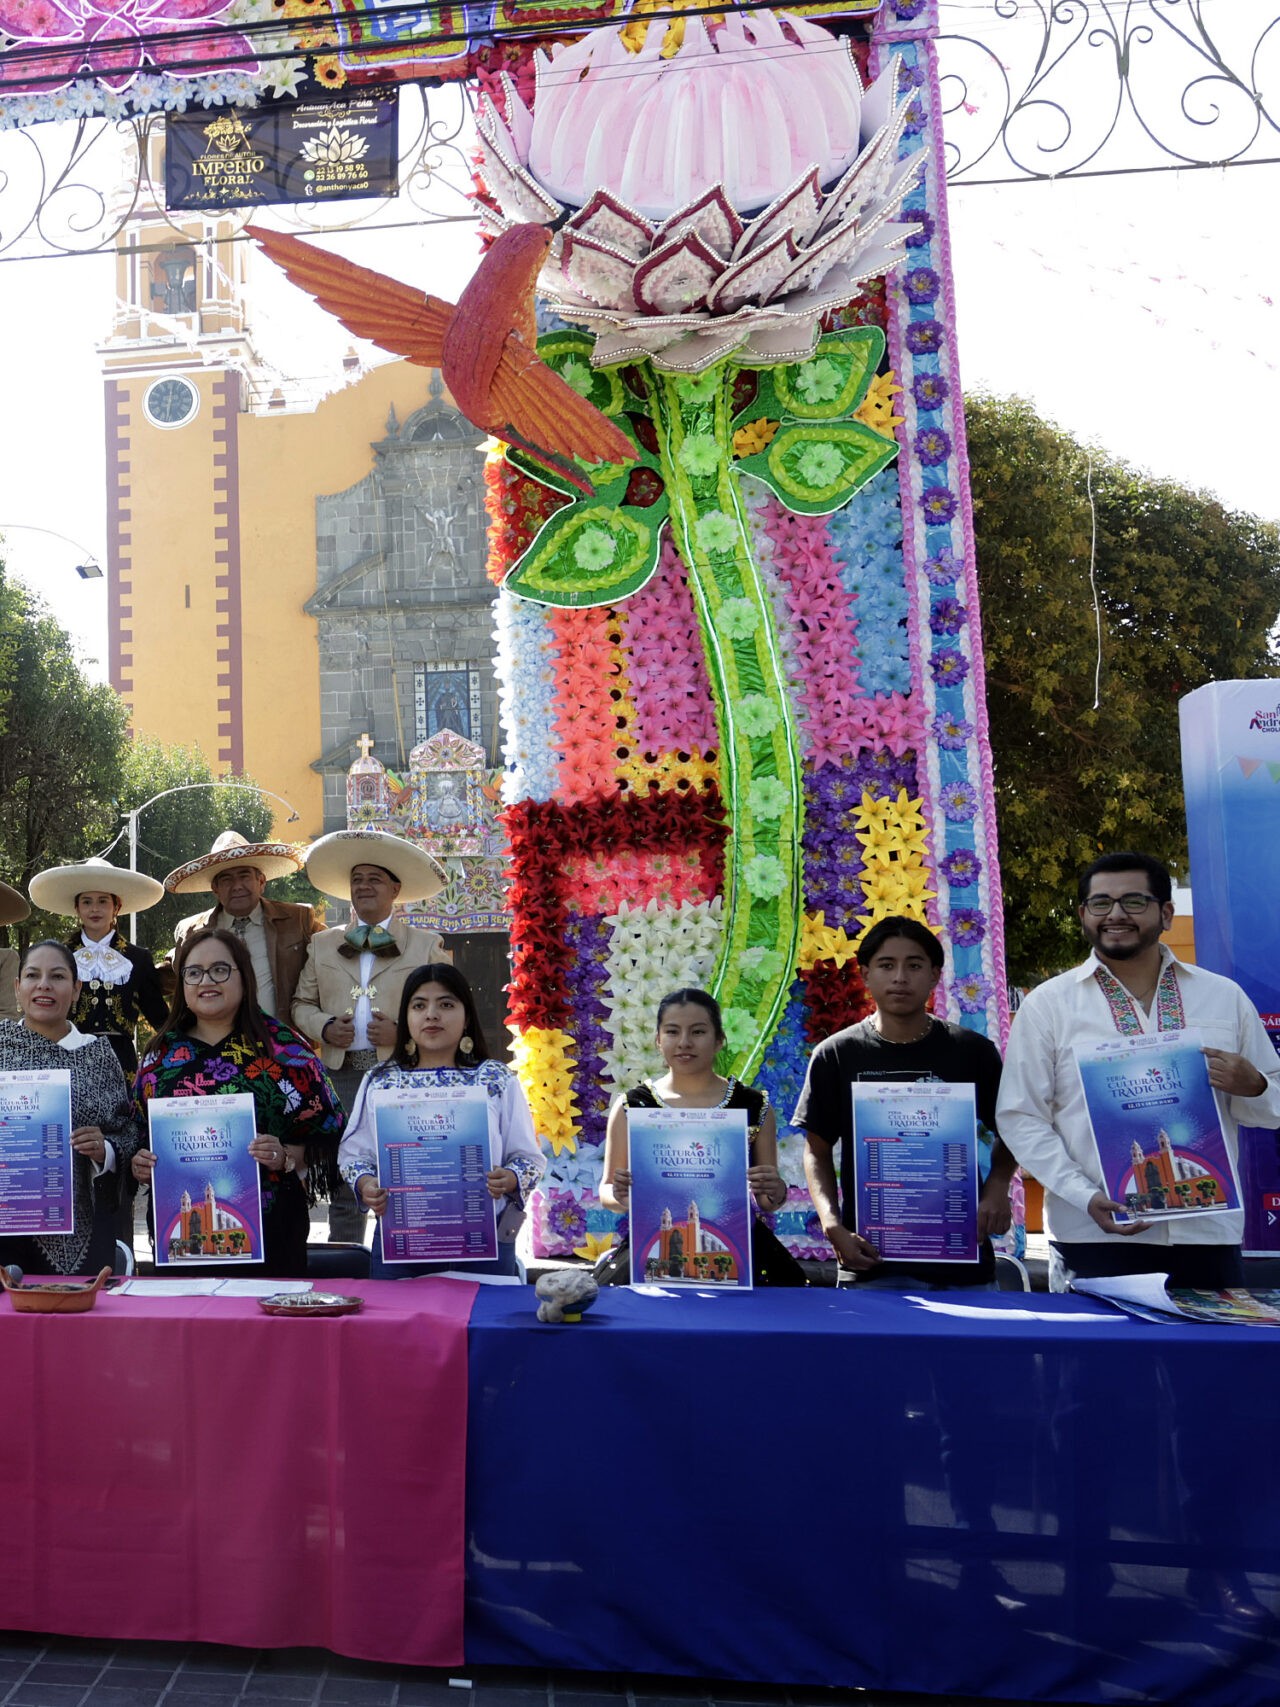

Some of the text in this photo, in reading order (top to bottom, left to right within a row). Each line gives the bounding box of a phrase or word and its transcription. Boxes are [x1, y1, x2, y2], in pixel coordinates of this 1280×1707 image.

[355, 163, 365, 171] 92
[348, 171, 357, 179] 76
[1255, 710, 1276, 719] San
[1249, 718, 1280, 729] Andr
